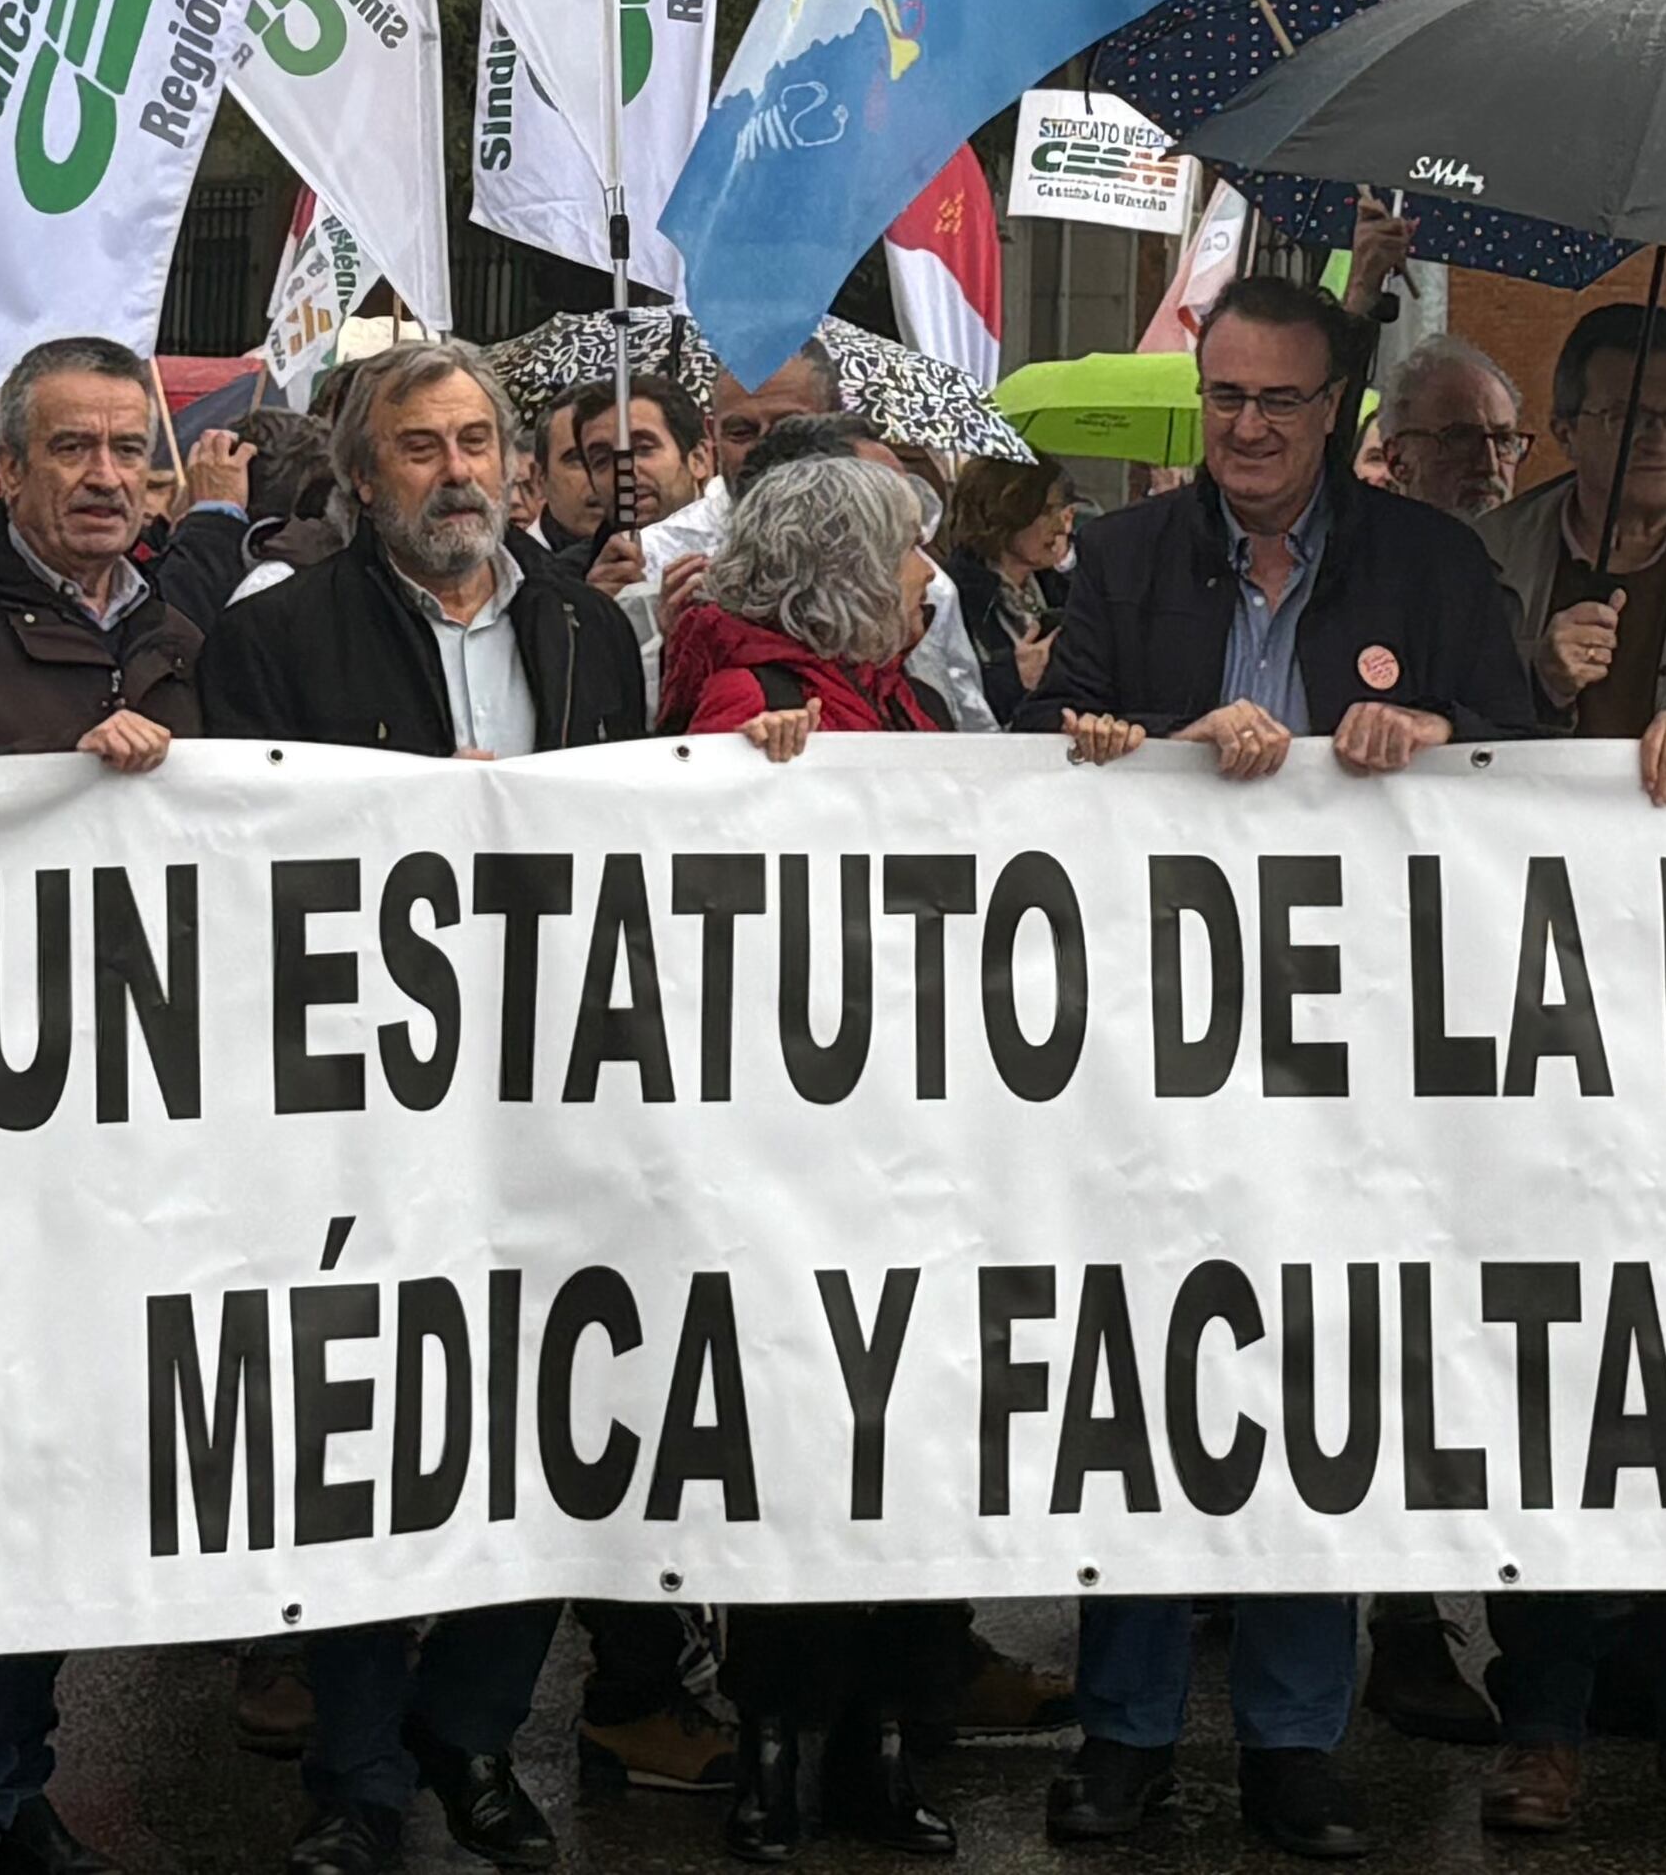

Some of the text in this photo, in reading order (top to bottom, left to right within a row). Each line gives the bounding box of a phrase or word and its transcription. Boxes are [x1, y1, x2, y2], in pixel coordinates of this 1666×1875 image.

[480, 16, 517, 171] Sindi
[1031, 141, 1180, 188] CESM
[270, 850, 1088, 1115] ESTATUTO
[1148, 855, 1348, 1097] DE
[1408, 855, 1614, 1097] LA
[147, 1215, 760, 1557] MÉDICA
[814, 1268, 920, 1521] Y
